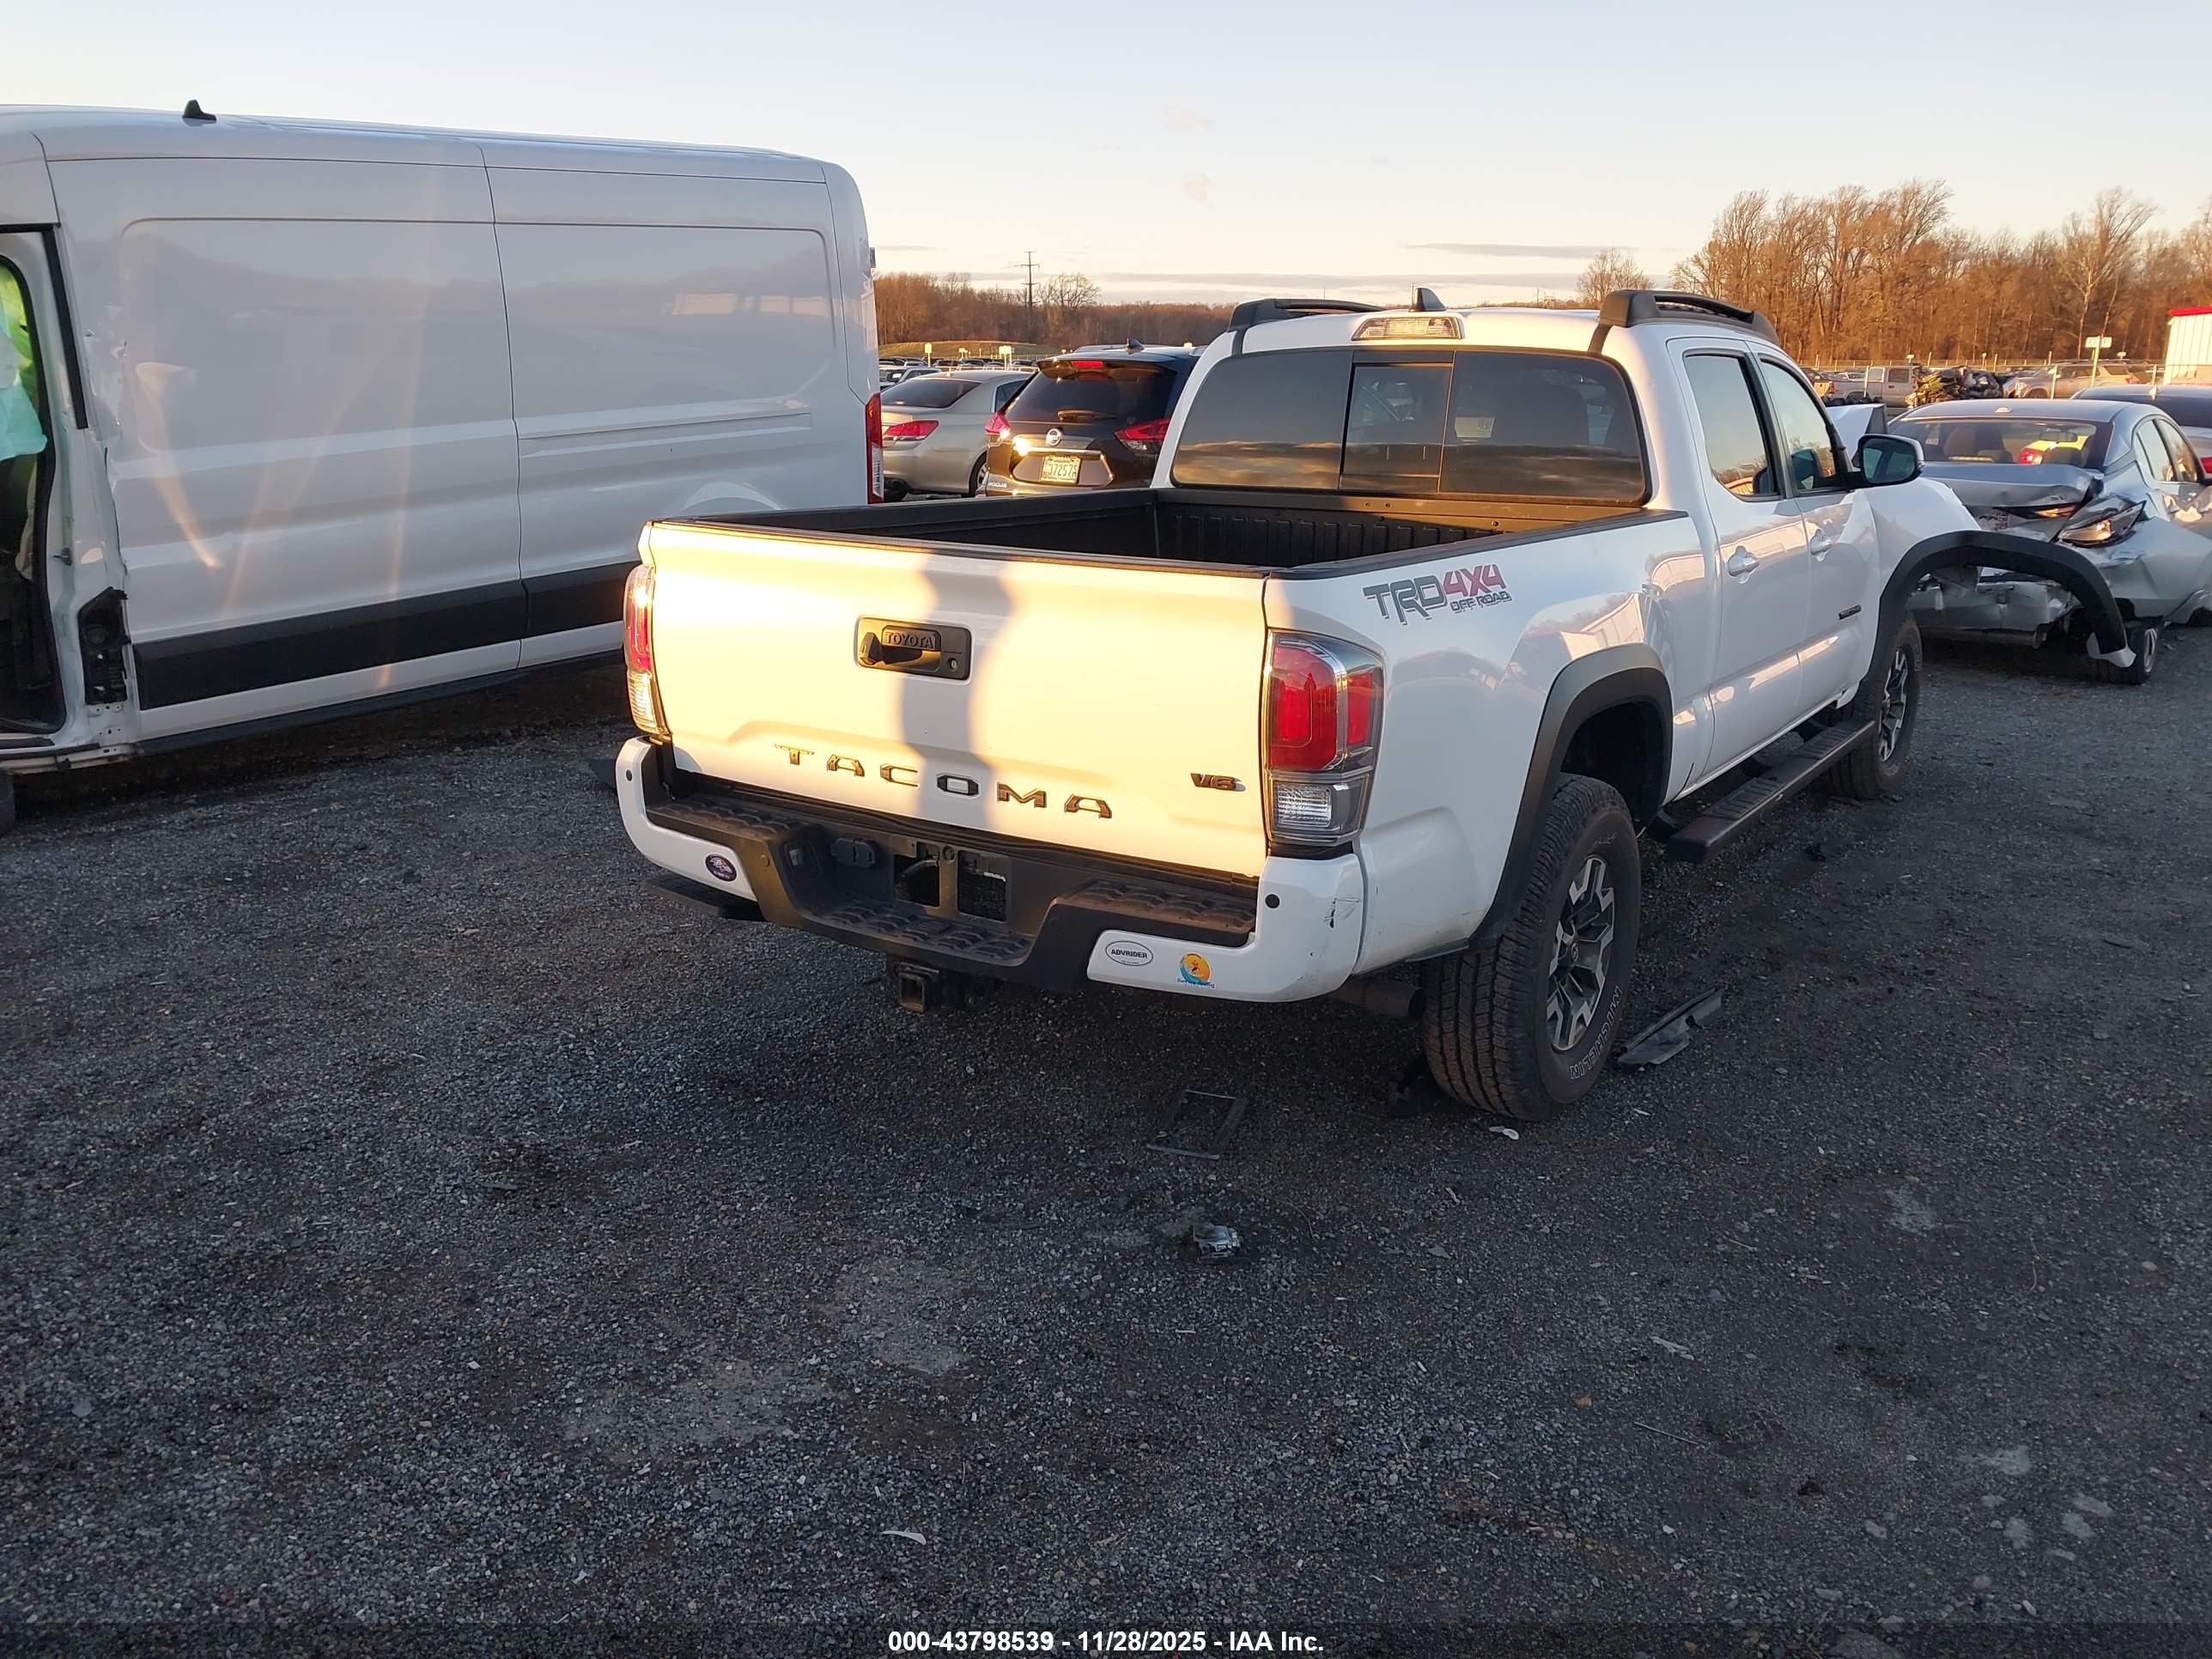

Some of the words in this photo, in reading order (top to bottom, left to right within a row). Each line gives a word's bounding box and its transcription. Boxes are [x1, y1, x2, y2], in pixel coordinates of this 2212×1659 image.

[1363, 574, 1448, 625] TRD
[1449, 598, 1475, 613] OFF
[1477, 591, 1512, 606] ROAD
[885, 632, 934, 649] TOYOTA
[775, 743, 1113, 819] TACOMA
[1190, 773, 1237, 791] V6
[1110, 949, 1148, 959] ADVRIDER
[1569, 985, 1622, 1080] MICHELIN
